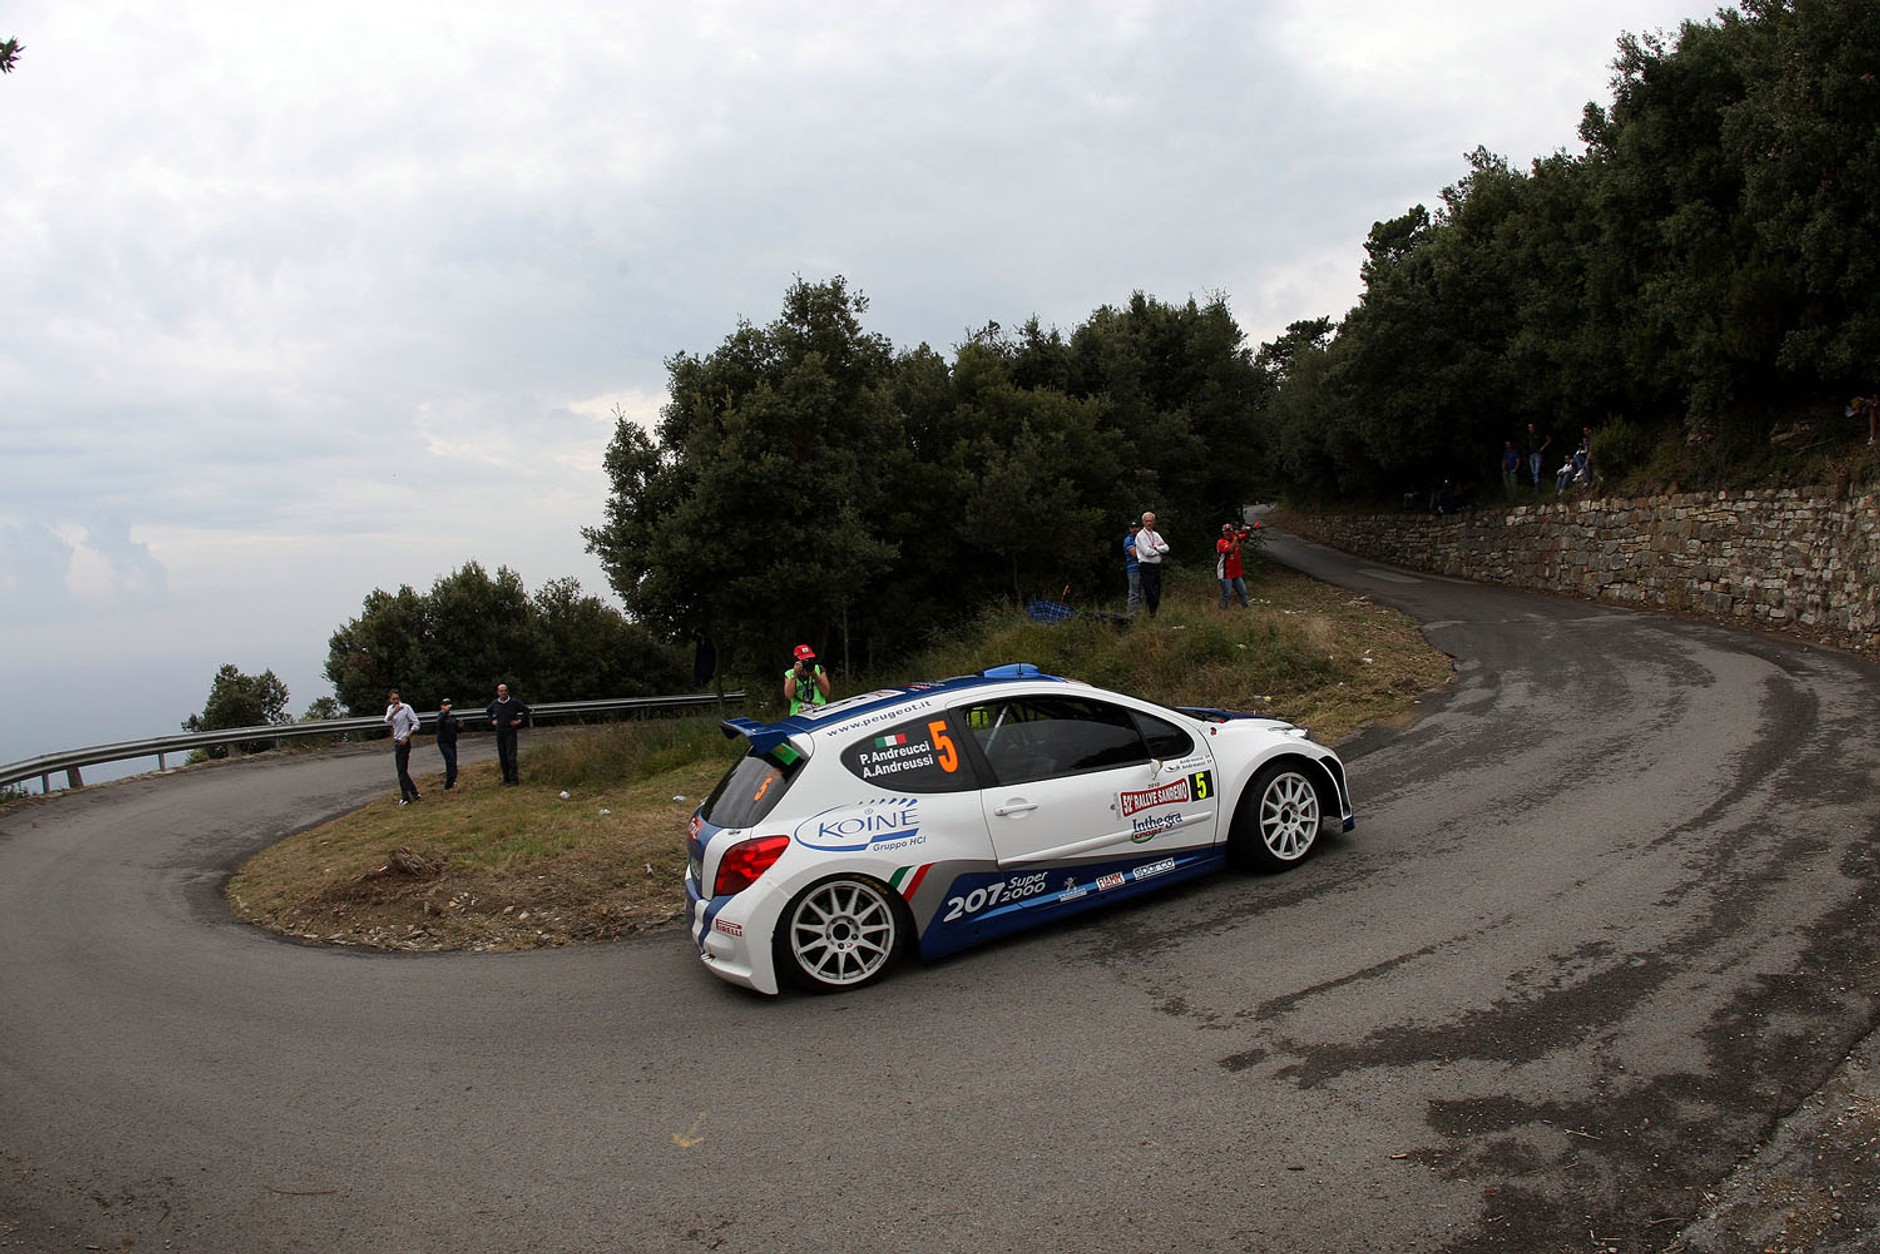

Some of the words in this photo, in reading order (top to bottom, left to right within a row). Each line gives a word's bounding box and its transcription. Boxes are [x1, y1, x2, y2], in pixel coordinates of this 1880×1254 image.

[826, 700, 932, 737] www.peugeot.it
[928, 720, 959, 773] 5
[863, 754, 934, 779] A.Andreussi
[754, 777, 773, 801] 5
[1134, 791, 1158, 810] RALLYE
[1157, 781, 1187, 803] SANREMO
[1195, 772, 1207, 799] 5
[1132, 812, 1183, 833] Inthegra
[873, 840, 908, 852] Gruppo
[1135, 859, 1174, 877] sparco
[1008, 871, 1048, 890] Super
[1098, 873, 1122, 889] FIAMM
[943, 882, 1006, 922] 207
[1001, 882, 1047, 903] 2000
[716, 918, 743, 937] PIRELLI
